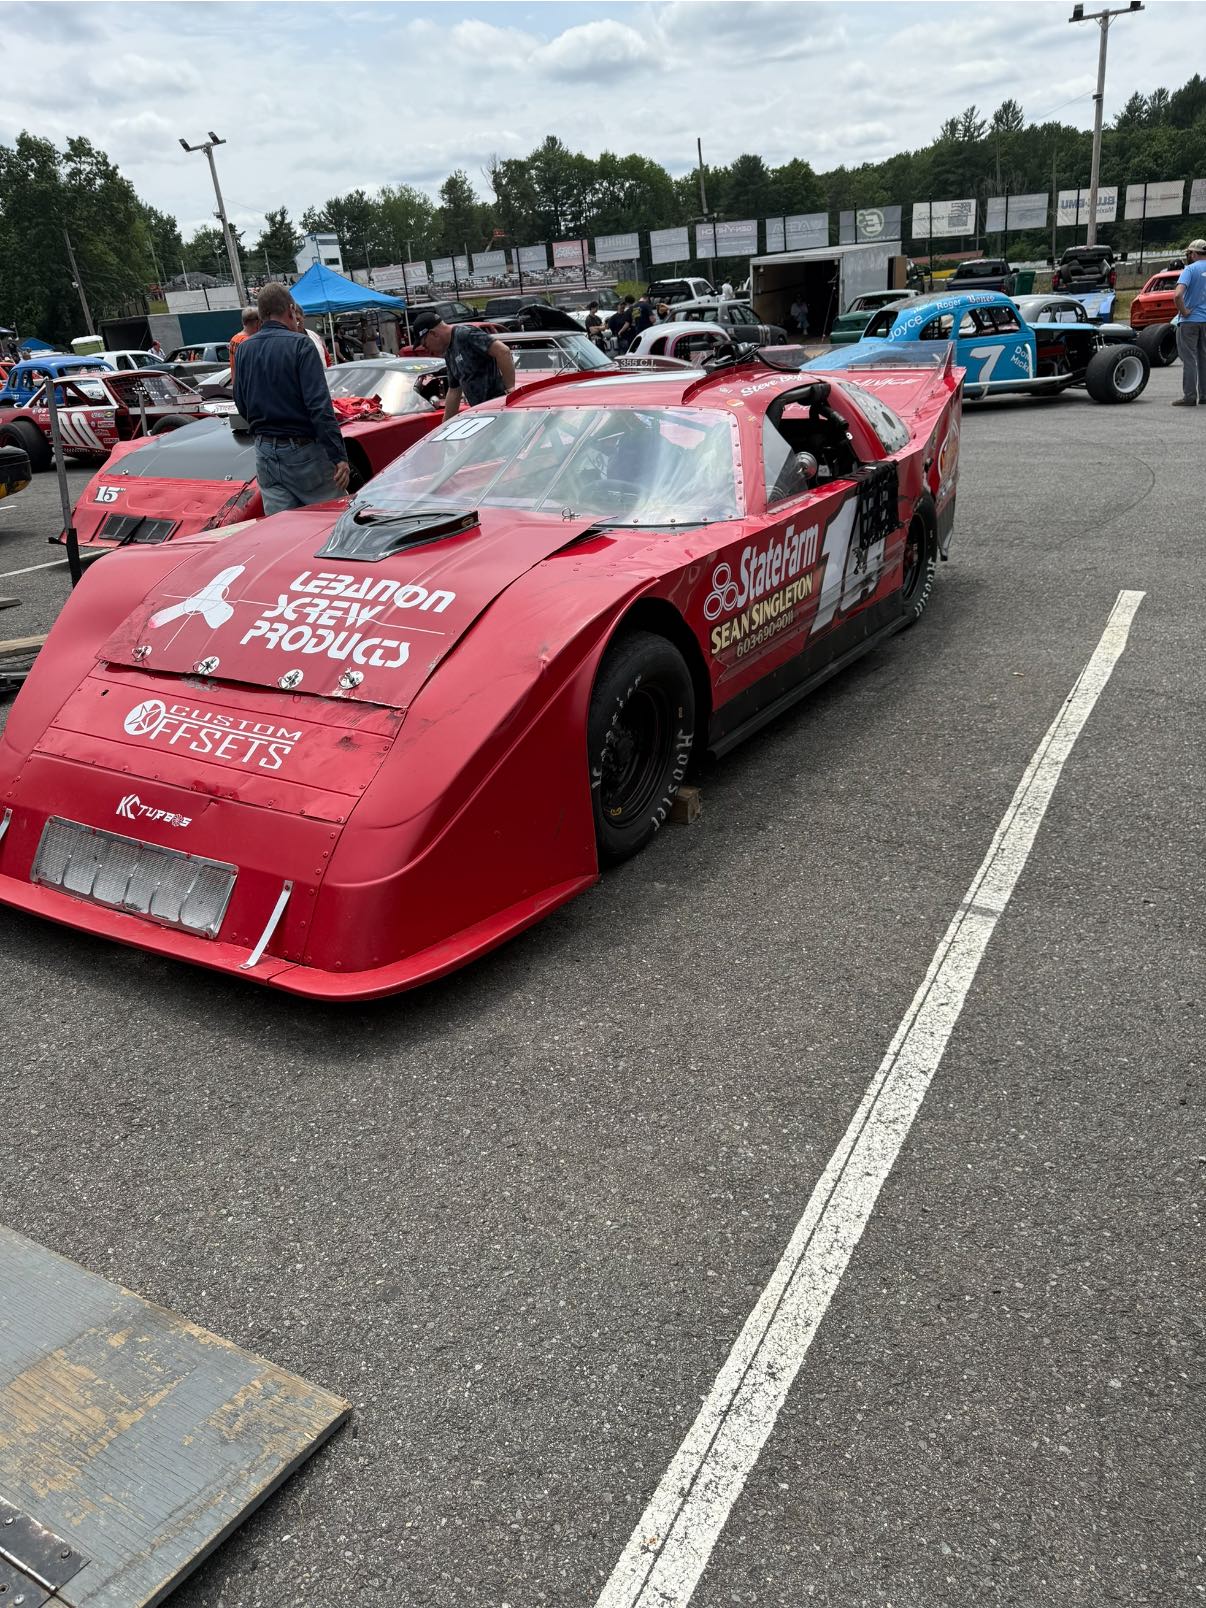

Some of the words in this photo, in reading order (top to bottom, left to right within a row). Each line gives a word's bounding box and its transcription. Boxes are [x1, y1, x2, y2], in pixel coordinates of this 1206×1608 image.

[936, 298, 961, 311] Roger
[889, 315, 923, 342] Joyce
[620, 359, 638, 367] 355
[970, 345, 1006, 384] 7
[740, 379, 777, 396] Steve
[430, 416, 497, 442] 10
[94, 486, 120, 502] 15
[289, 570, 456, 613] LEBANON
[262, 594, 384, 628] SCREW
[711, 610, 749, 655] SEAN
[751, 572, 813, 630] SINGLETON
[240, 620, 411, 668] PRODUCTS
[169, 704, 303, 741] CUSTOM
[115, 793, 140, 819] KC
[139, 804, 192, 828] TURBOS
